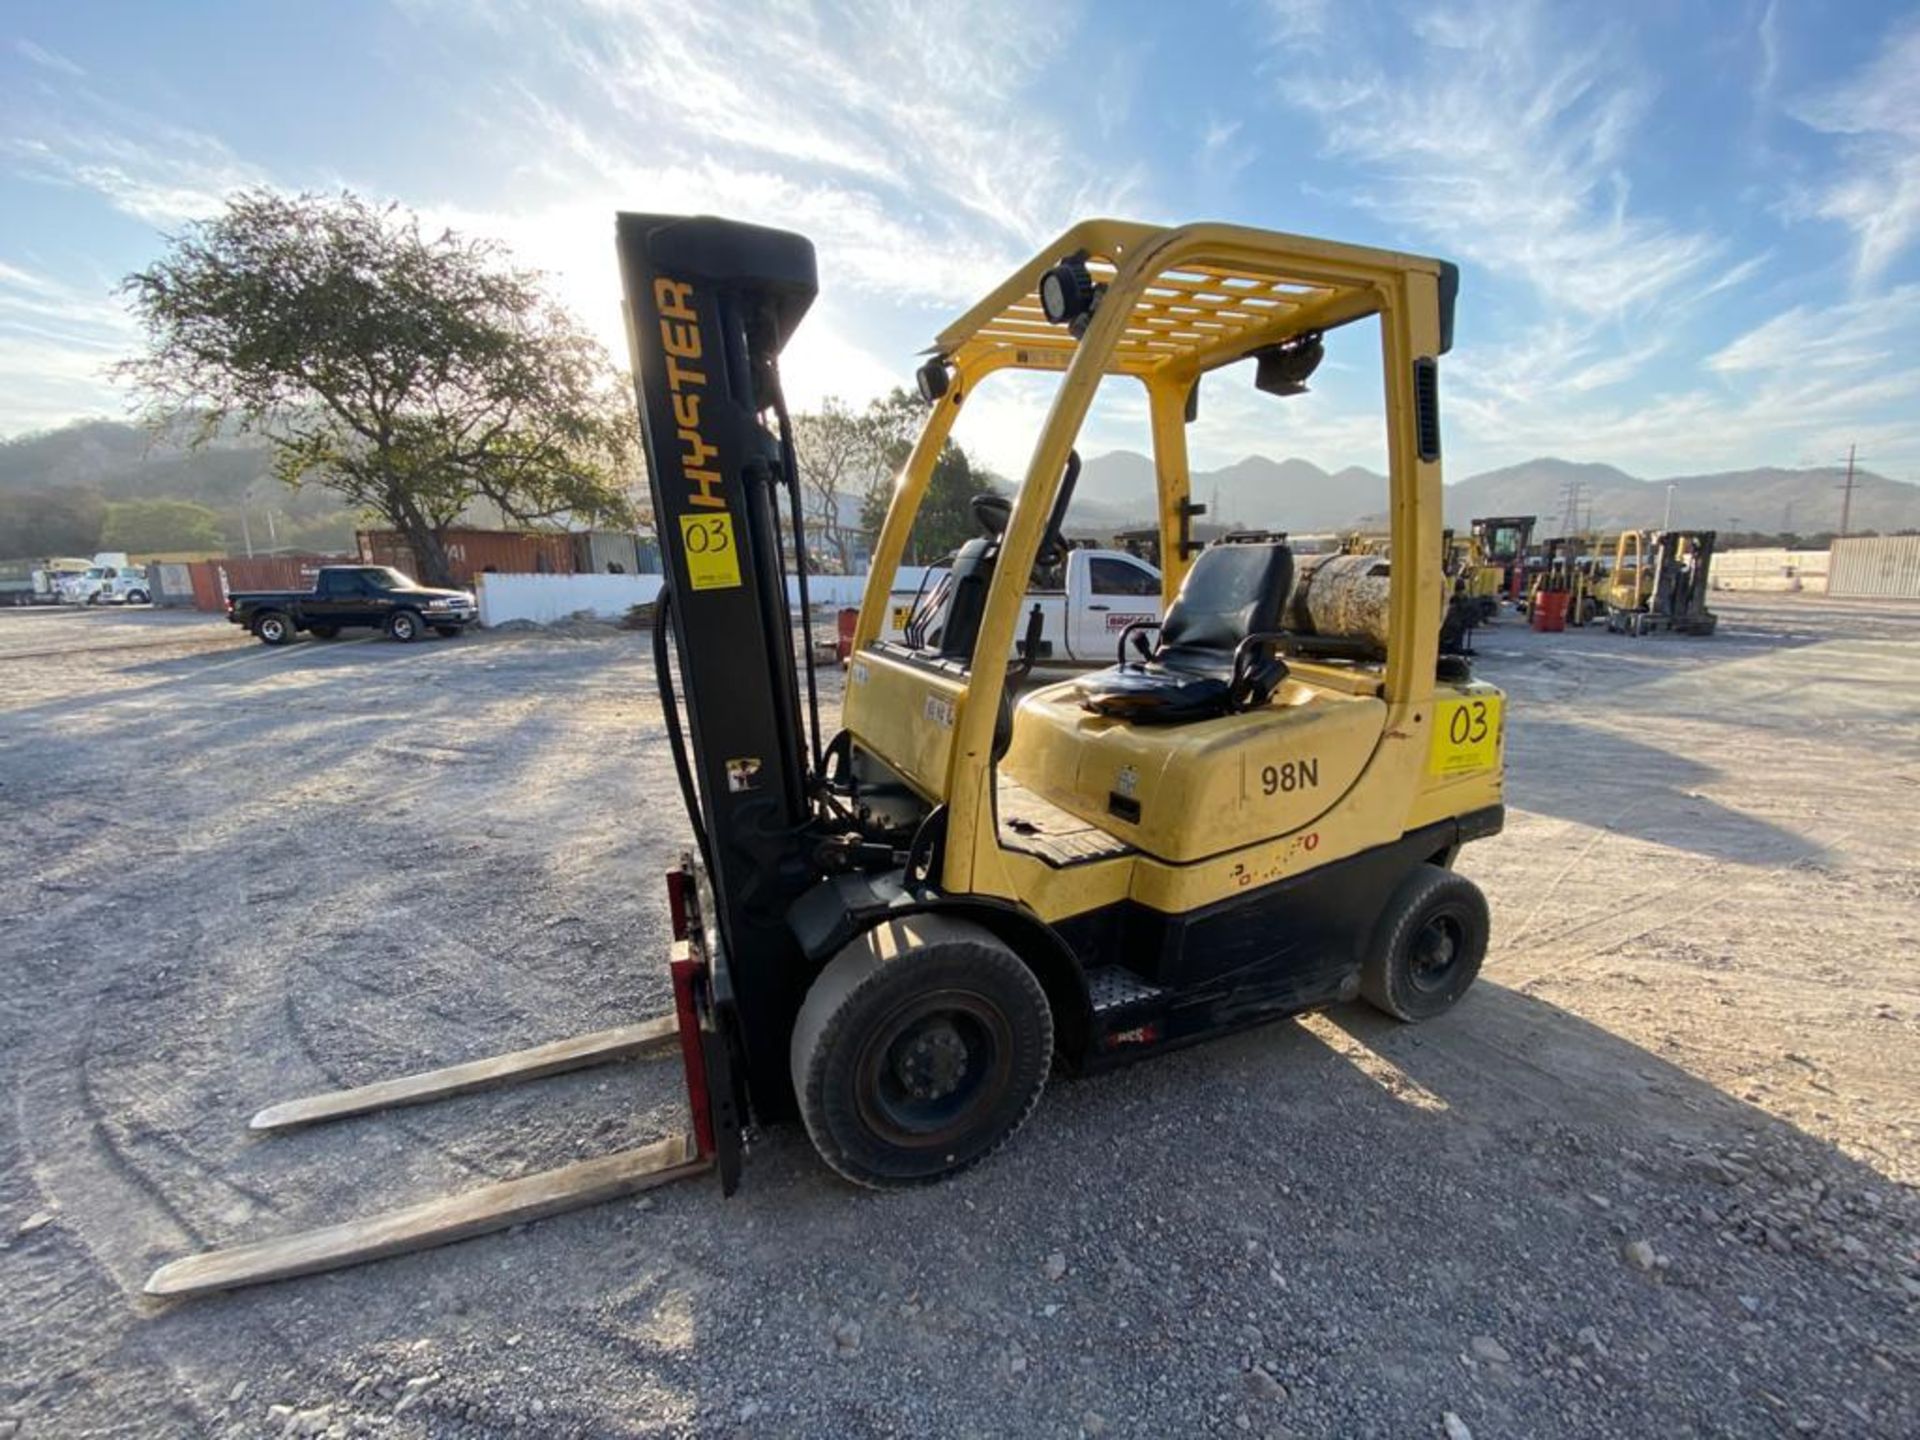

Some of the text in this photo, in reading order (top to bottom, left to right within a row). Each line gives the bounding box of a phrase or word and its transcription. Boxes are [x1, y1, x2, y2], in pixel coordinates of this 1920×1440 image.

[655, 277, 726, 508] HYSTER
[686, 518, 728, 553] 03
[1450, 701, 1488, 745] 03
[1262, 758, 1318, 796] 98N
